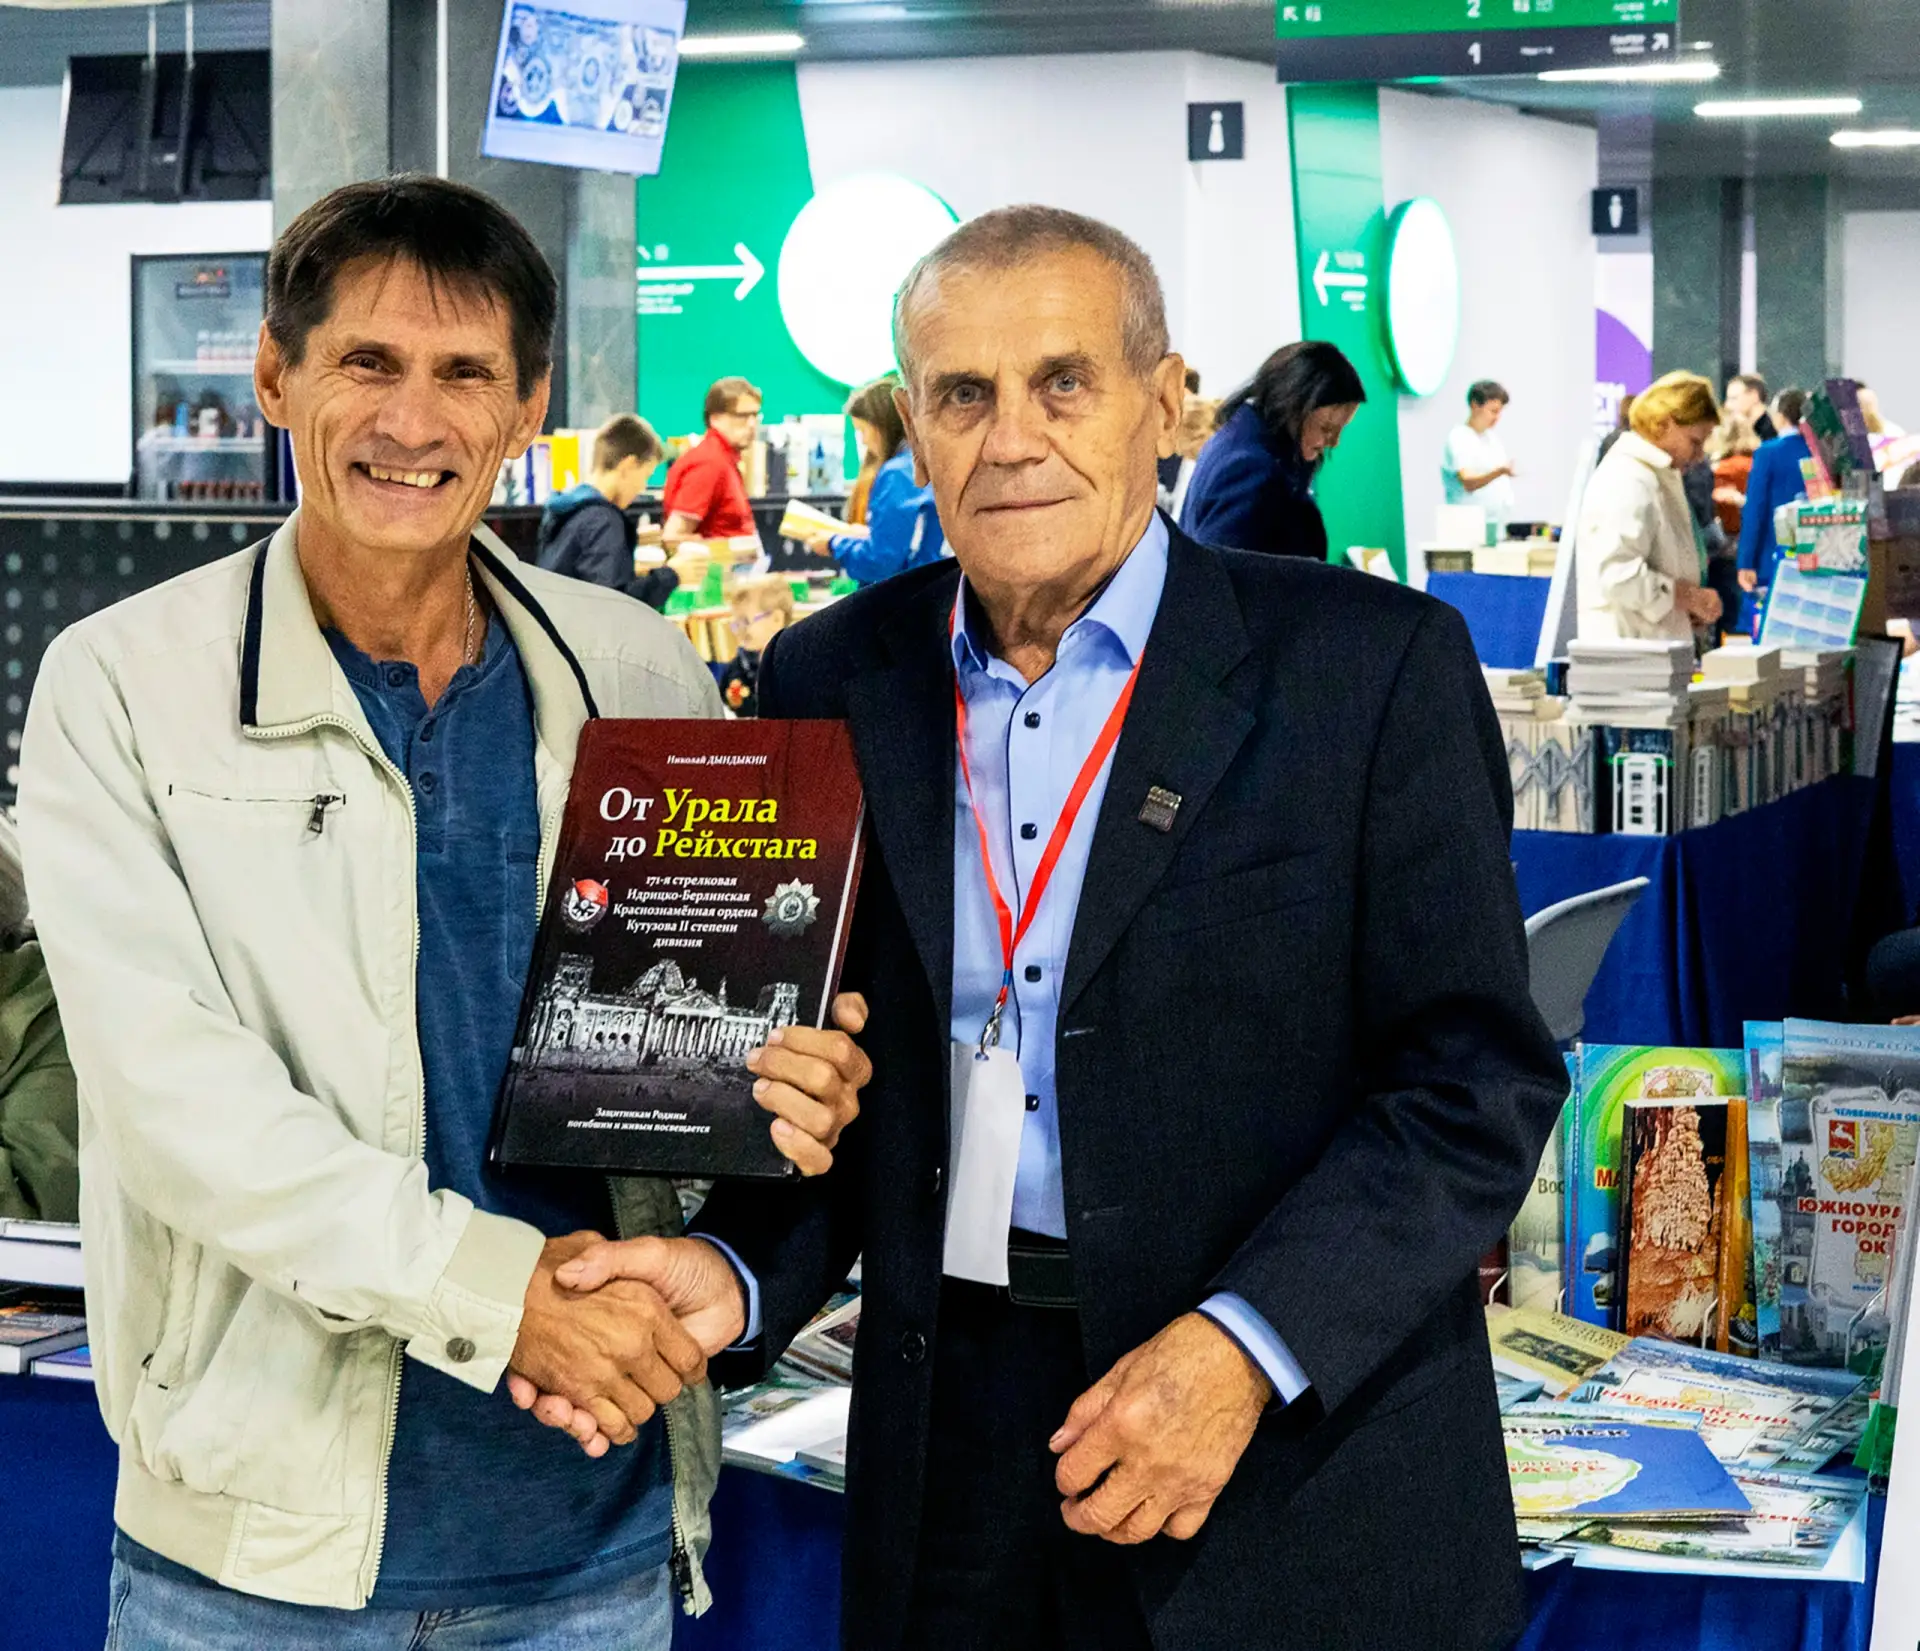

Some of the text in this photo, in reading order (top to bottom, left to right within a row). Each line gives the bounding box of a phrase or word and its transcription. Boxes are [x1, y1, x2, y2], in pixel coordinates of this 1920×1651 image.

[1467, 42, 1481, 65] 1
[667, 755, 767, 766] Николай ДЫНДЫКИН
[599, 787, 778, 832] От Урала
[604, 829, 818, 862] до Рейхстага
[645, 876, 737, 888] 171-я стрелковая
[627, 889, 751, 904] Идрицко-Берлинская
[613, 903, 758, 920] Краснознамённая ордена
[626, 919, 738, 934] Кутузова II степени
[653, 937, 703, 948] дивизия
[595, 1107, 687, 1121] Защитникам Родины
[567, 1119, 612, 1129] погибшим
[621, 1122, 653, 1130] живым
